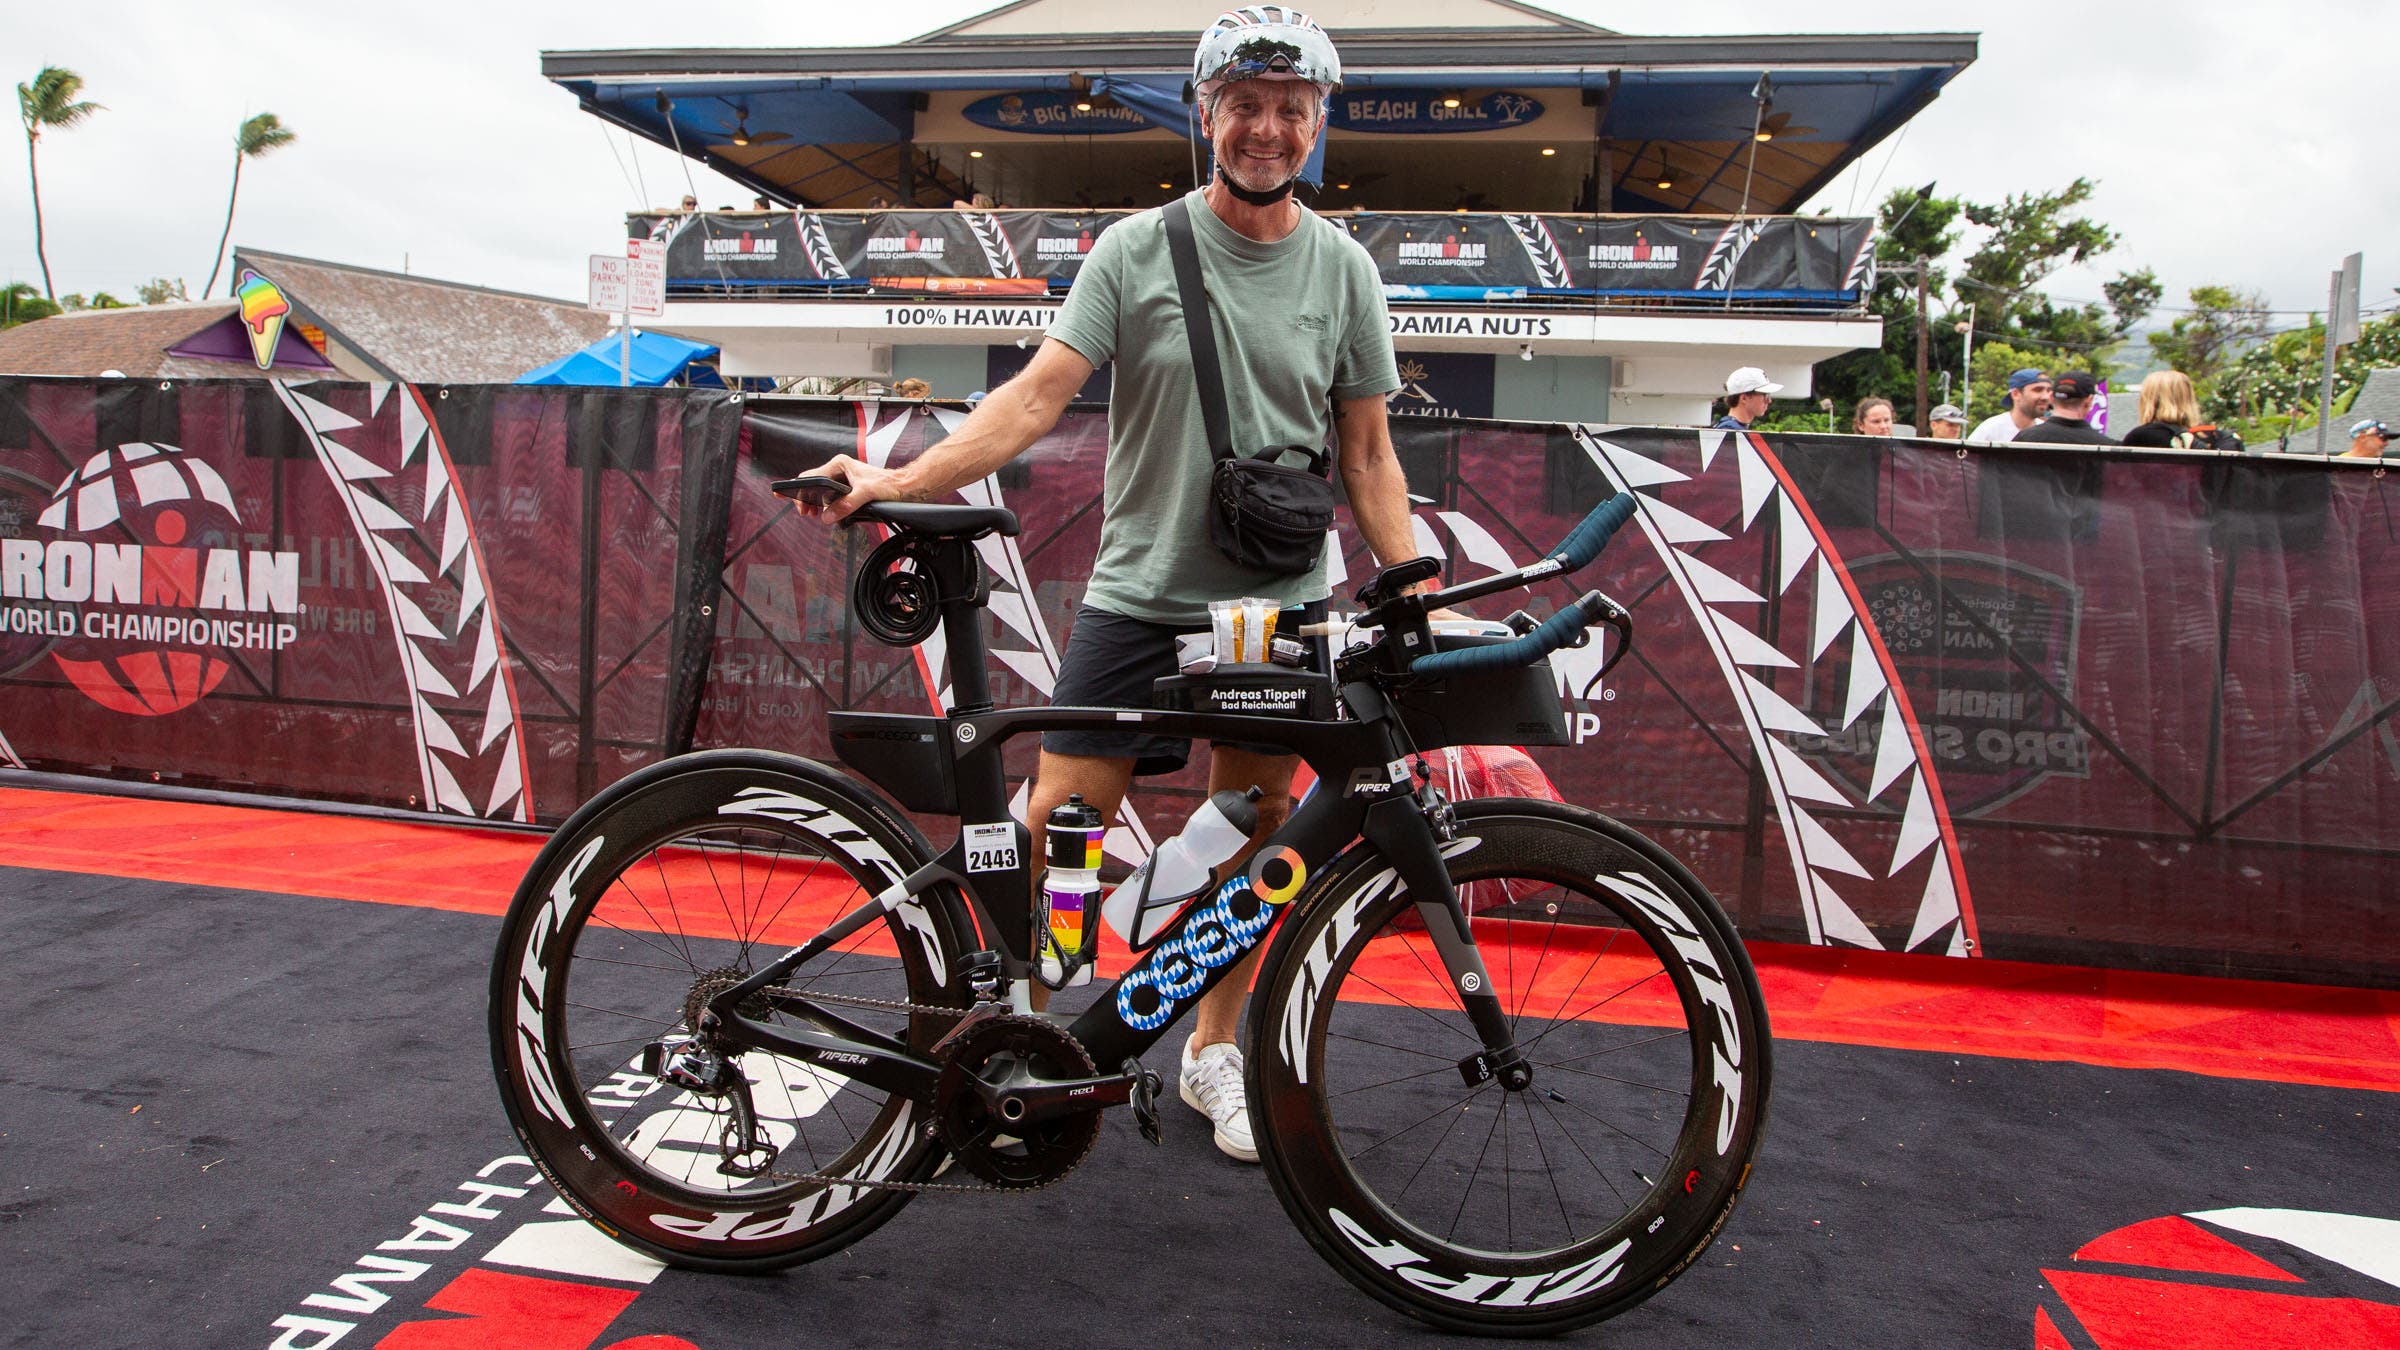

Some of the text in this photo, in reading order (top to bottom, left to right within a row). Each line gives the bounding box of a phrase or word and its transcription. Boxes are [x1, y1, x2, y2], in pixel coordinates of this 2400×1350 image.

[1033, 105, 1067, 124] BIG
[1347, 100, 1488, 121] BEACH GRILL
[704, 231, 778, 254] IRONMAN
[866, 230, 945, 252] IRONMAN
[1037, 230, 1094, 253] IRONM
[1398, 235, 1487, 258] IRONMAN
[1588, 237, 1679, 261] IRONMAN
[704, 253, 777, 261] WORLD CHAMPIONSHIP
[866, 252, 943, 260] WORLD CHAMPIONSHIP
[1037, 253, 1063, 261] WORLD
[1399, 258, 1485, 267] WORLD CHAMPIONSHIP
[1588, 261, 1677, 270] WORLD CHAMPIONSHIP
[602, 261, 617, 273] NO
[591, 271, 626, 285] PARKING
[885, 308, 946, 326] 100%
[1482, 317, 1551, 336] NUTS
[0, 510, 299, 614] RONMAN
[83, 611, 297, 650] CHAMPIONSHIP
[1211, 688, 1307, 703] Andreas Tippelt
[1221, 700, 1296, 710] Bad Reichenhall
[1354, 783, 1391, 793] VIPER
[871, 805, 913, 846] CONTINENTAL
[974, 825, 1007, 835] IRONMAN
[969, 848, 1017, 870] 2443
[1300, 872, 1341, 917] CONTINENTAL
[516, 835, 605, 1130] ZIPP
[1595, 871, 1742, 1156] ZIPP
[579, 1143, 597, 1161] 808
[648, 1099, 916, 1241] ZIPP
[537, 1160, 594, 1219] COMPETITION
[1647, 1215, 1665, 1234] 808
[1686, 1193, 1736, 1264] ATTACK COMP
[1328, 1207, 1633, 1307] ZIPP
